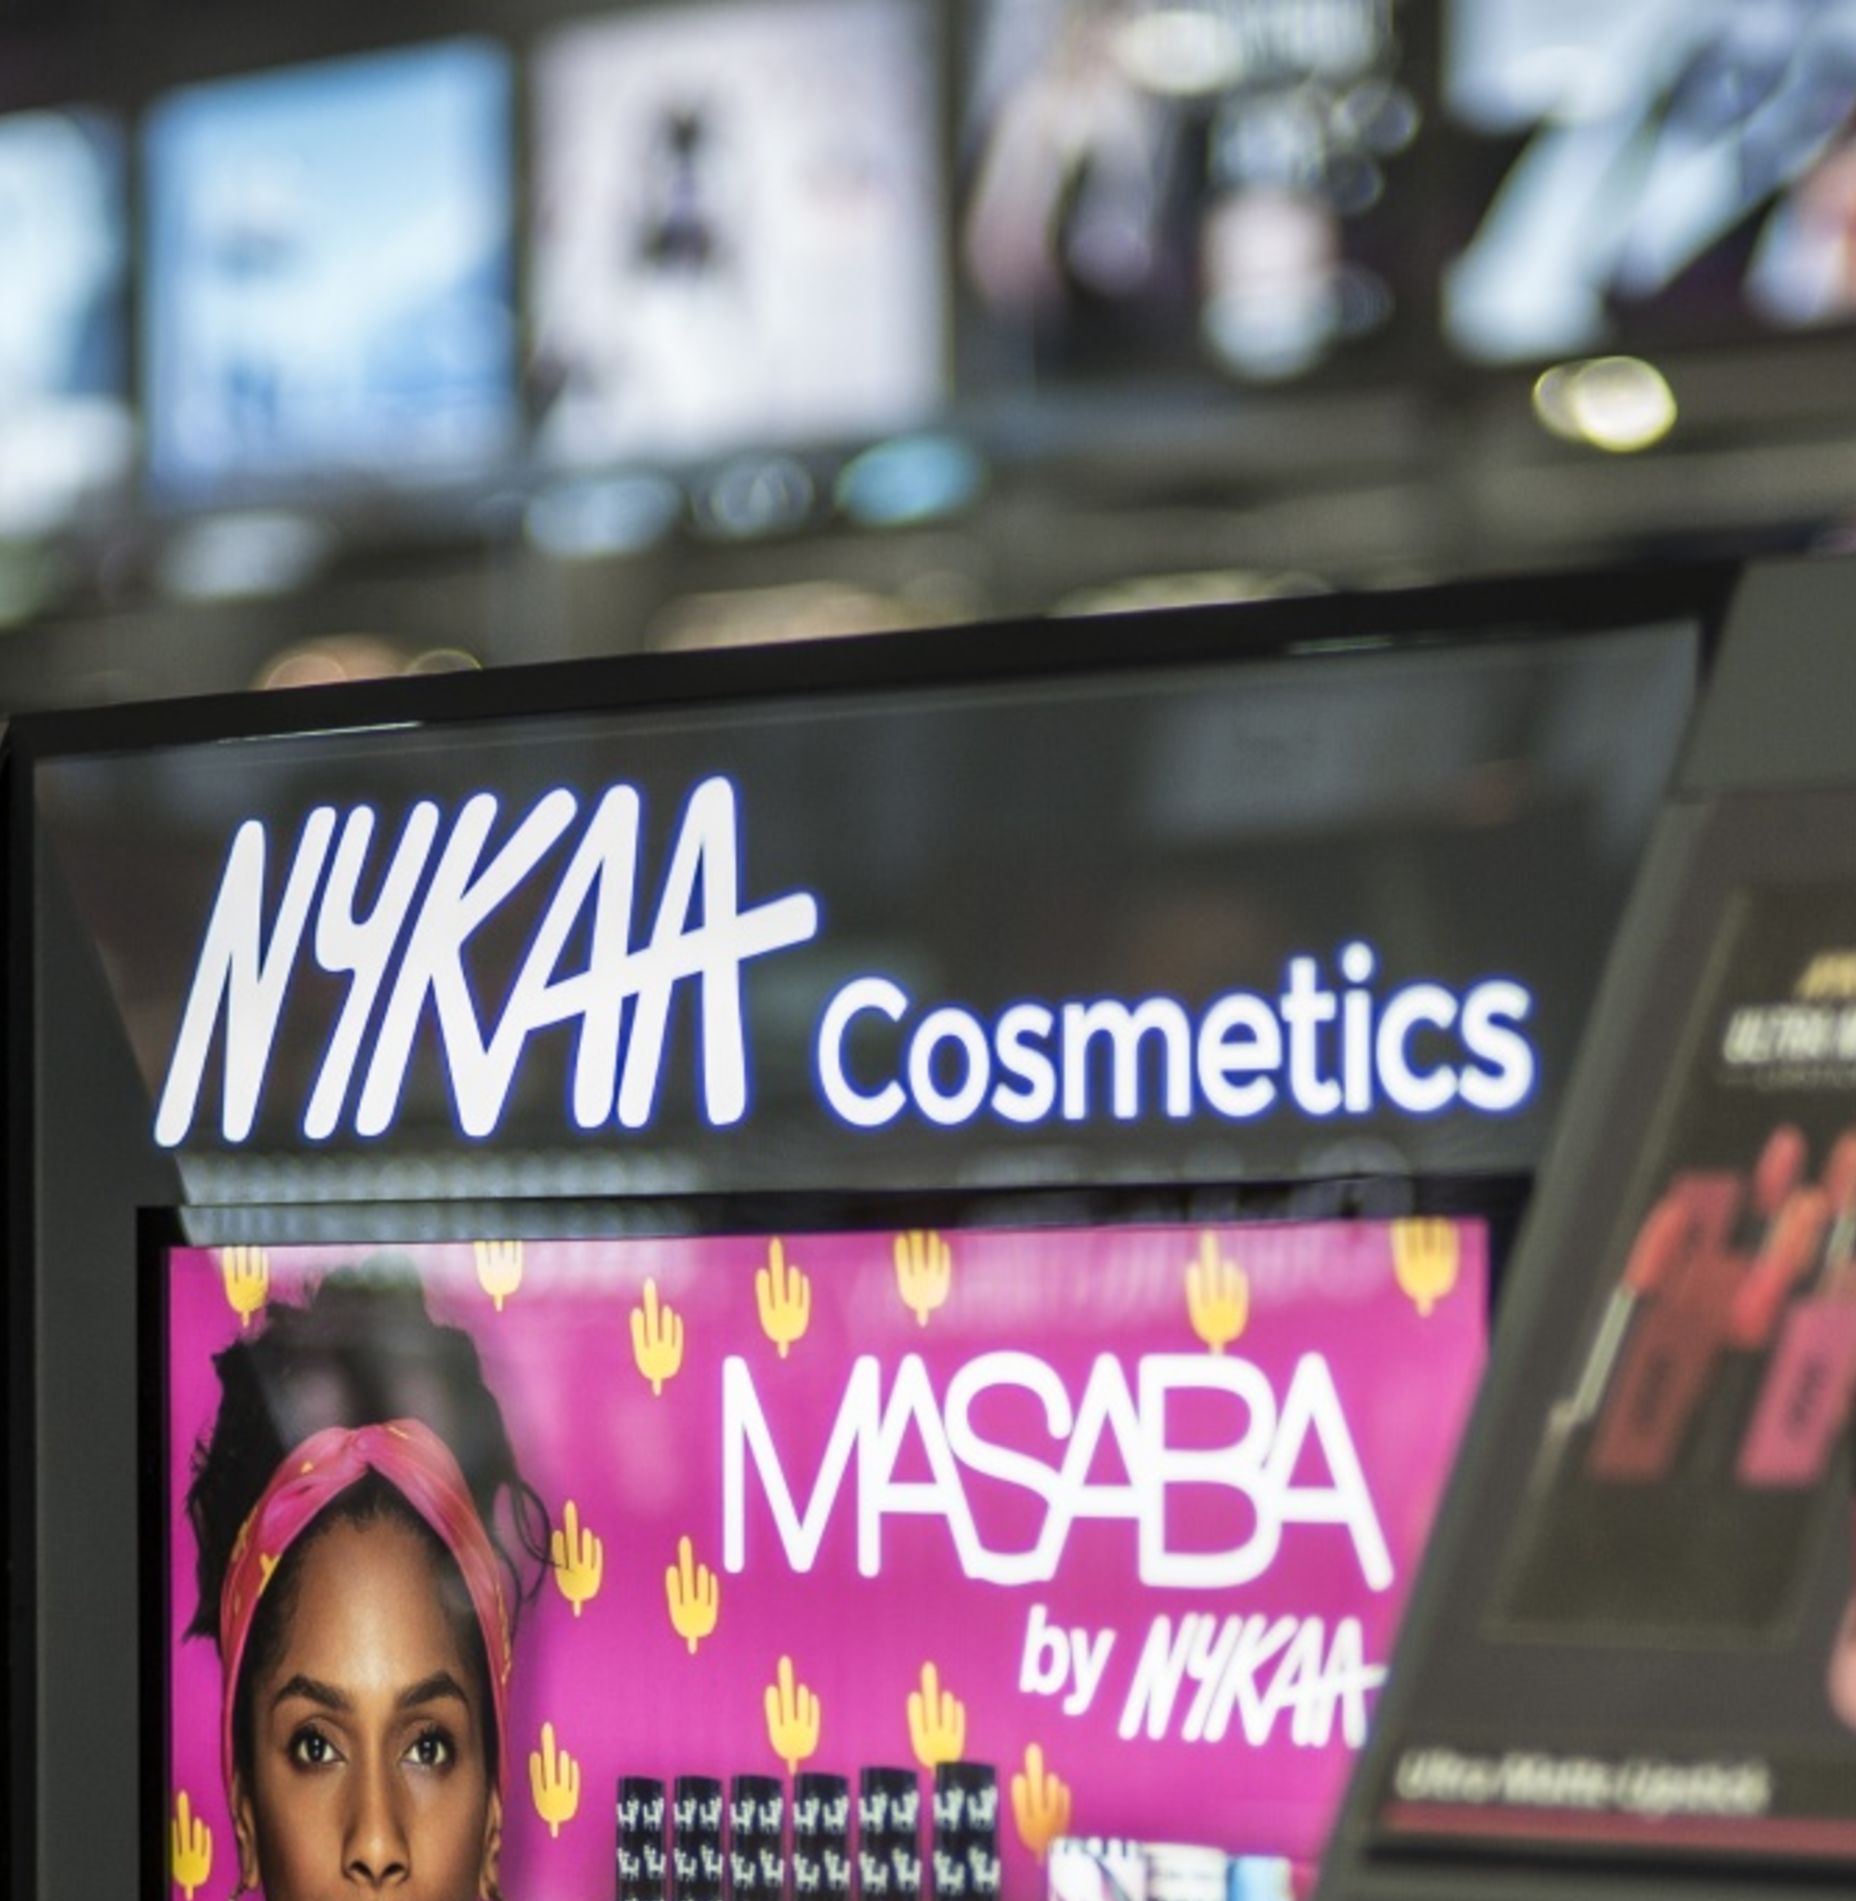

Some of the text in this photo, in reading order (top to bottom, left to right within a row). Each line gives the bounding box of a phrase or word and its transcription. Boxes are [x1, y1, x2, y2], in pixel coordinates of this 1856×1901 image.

[154, 777, 1536, 1146] NYKAA Cosmetics
[723, 1349, 1393, 1591] MASABA
[1021, 1605, 1387, 1748] by NYKAA
